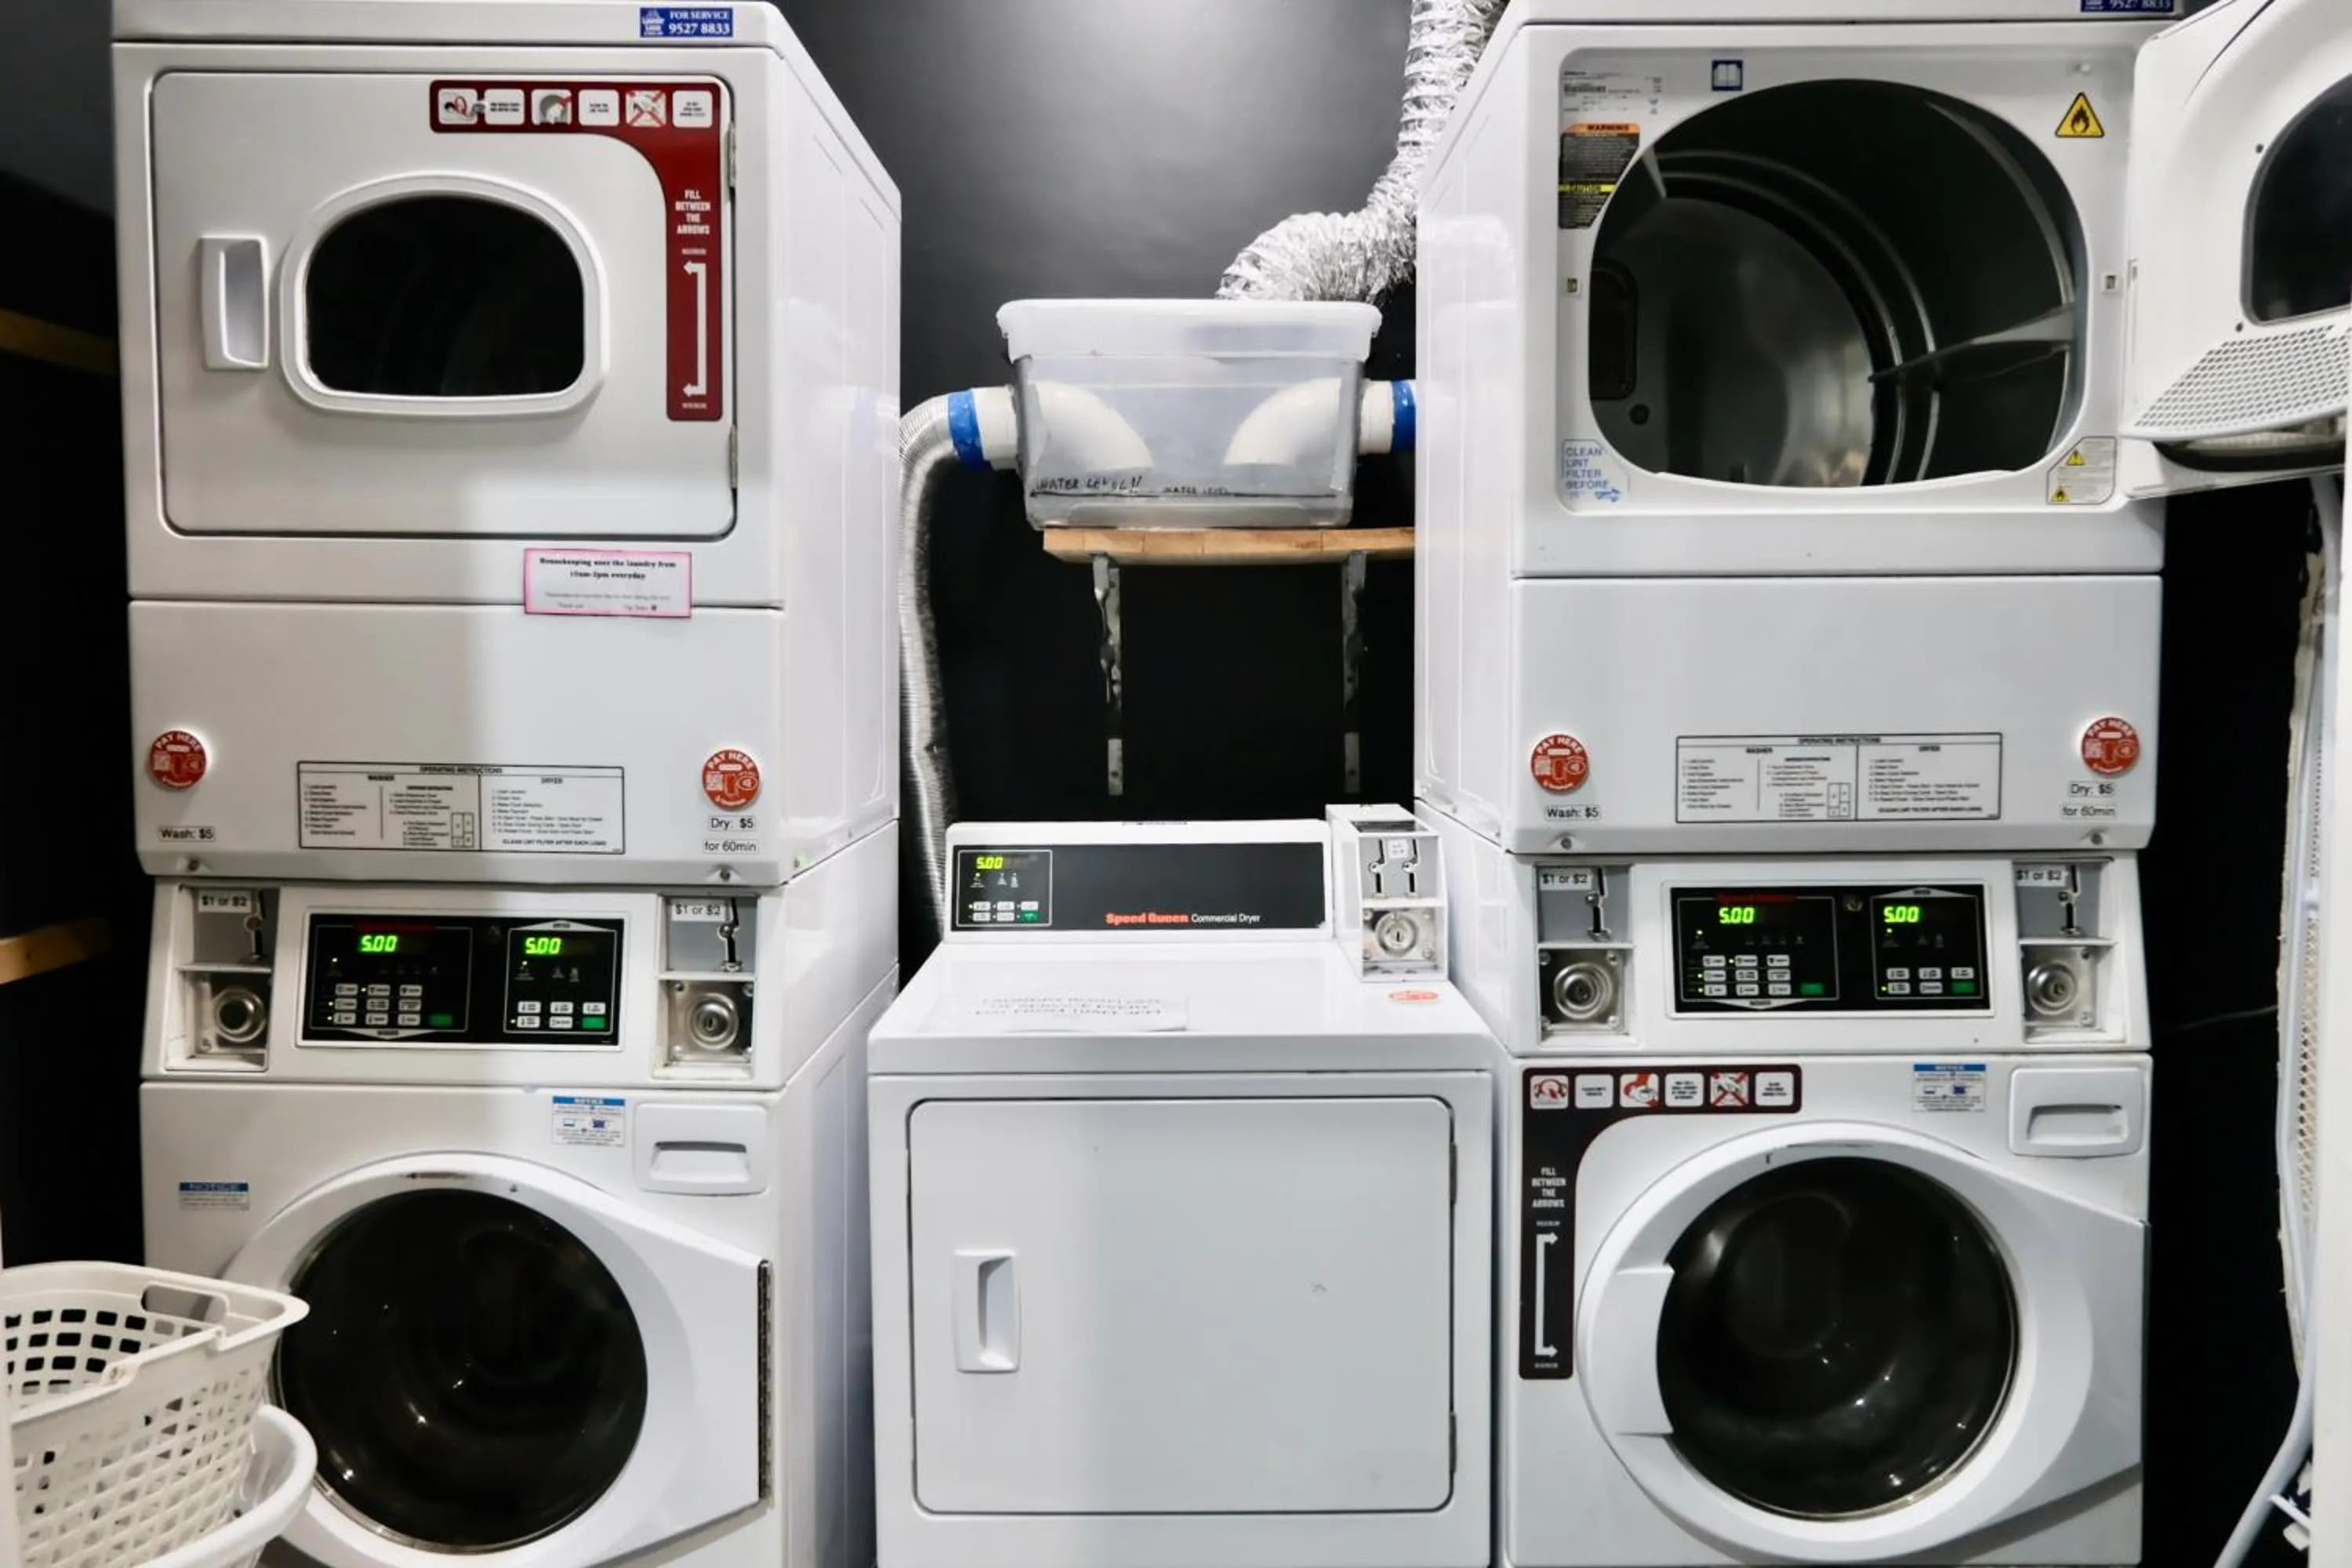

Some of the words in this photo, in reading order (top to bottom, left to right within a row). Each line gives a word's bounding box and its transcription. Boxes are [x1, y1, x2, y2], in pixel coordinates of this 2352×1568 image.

[670, 11, 689, 20] FOR
[690, 11, 729, 20] SERVICE
[669, 24, 698, 34] 9527
[700, 24, 730, 34] 8833
[684, 190, 701, 200] FILL
[675, 201, 711, 211] BETWEEN
[686, 213, 701, 223] THE
[677, 224, 710, 234] ARROWS
[1566, 447, 1602, 456] CLEAN
[1566, 459, 1588, 468] LINT
[1566, 469, 1602, 478] FILTER
[1036, 477, 1079, 491] WATER
[539, 557, 592, 567] Housekeeping
[626, 560, 655, 568] laundry
[612, 572, 646, 581] everyday
[707, 752, 726, 769] PAY
[728, 751, 754, 771] HERE
[1585, 807, 1599, 818] $5
[711, 818, 733, 829] Dry:
[740, 818, 753, 829] $5
[198, 829, 214, 839] $5
[705, 840, 720, 851] for
[722, 840, 757, 851] 60min
[1542, 873, 1554, 884] $1
[1573, 873, 1588, 884] $2
[676, 903, 688, 915] $1
[706, 904, 720, 916] $2
[1105, 913, 1145, 925] Speed
[1148, 913, 1189, 924] Queen
[1191, 913, 1237, 924] Commercial
[1239, 913, 1261, 924] Dryer
[1541, 1167, 1556, 1176] FILL
[1532, 1178, 1566, 1187] BETWEEN
[1542, 1189, 1556, 1198] THE
[1532, 1200, 1565, 1208] ARROWS
